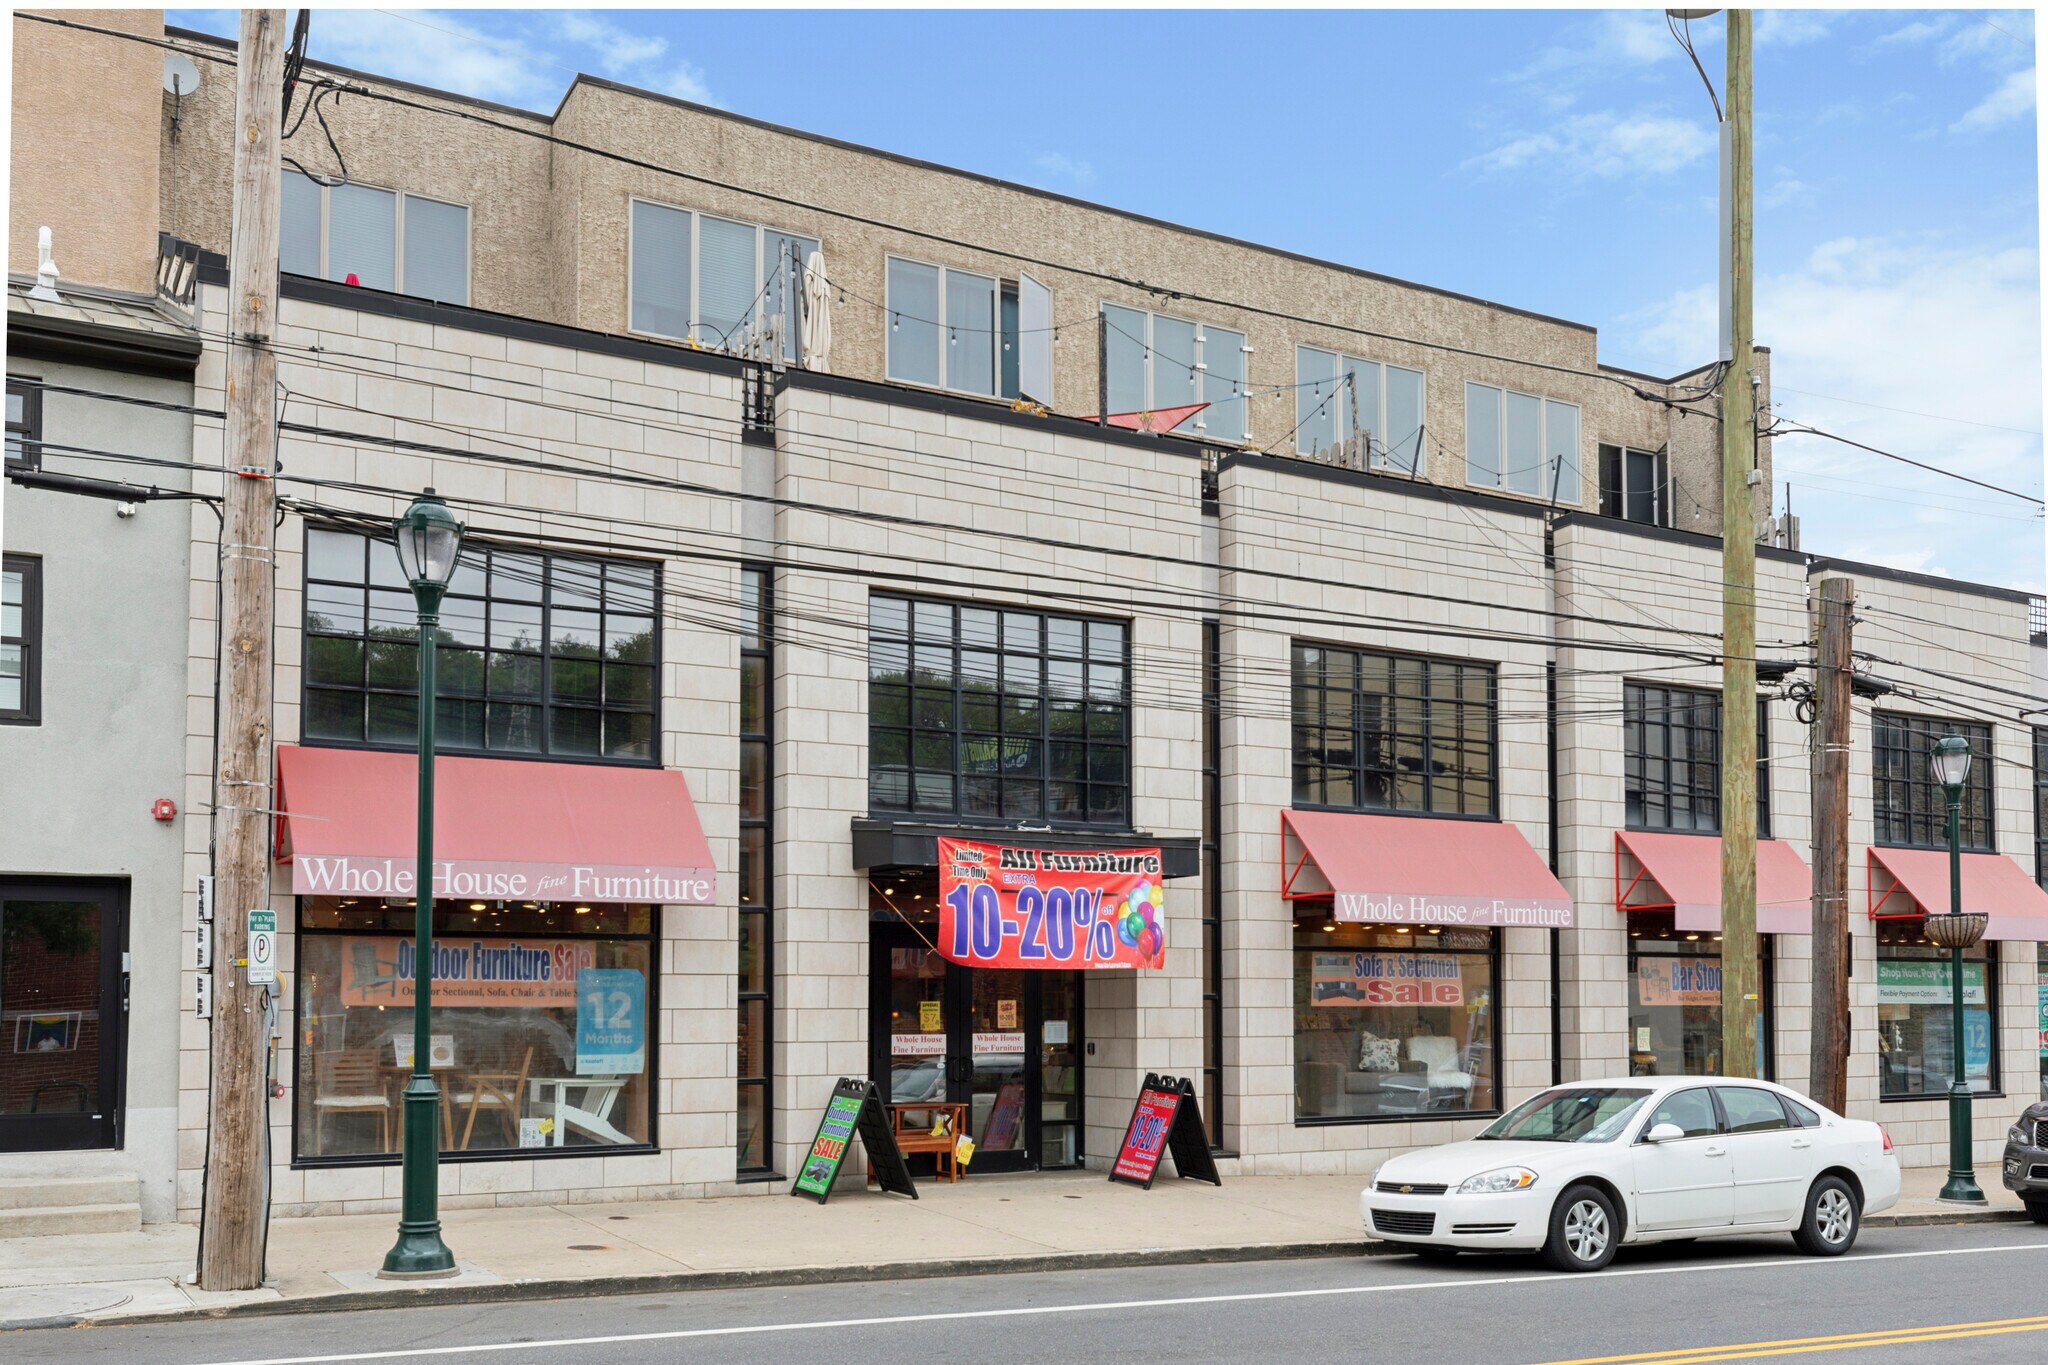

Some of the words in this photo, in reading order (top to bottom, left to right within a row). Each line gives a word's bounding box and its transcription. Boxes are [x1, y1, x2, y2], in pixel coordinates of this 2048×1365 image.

[956, 849, 983, 863] Limited
[1000, 848, 1037, 872] All
[1040, 851, 1160, 875] Furniture
[299, 857, 414, 894] Whole
[432, 862, 527, 897] House
[531, 875, 568, 897] fine
[571, 867, 709, 901] Furniture
[952, 865, 970, 878] Time
[970, 867, 987, 880] Only
[1003, 873, 1037, 884] EXTRA
[1102, 905, 1113, 915] off
[1341, 894, 1404, 921] Whole
[1409, 896, 1467, 923] House
[1469, 905, 1489, 924] fine
[1492, 900, 1571, 926] Furniture
[946, 882, 1115, 961] 10-20%
[258, 938, 265, 957] P
[472, 941, 551, 983] Furniture
[553, 942, 593, 982] Sale
[1354, 953, 1384, 979] Sofa
[1386, 956, 1396, 978] &
[1398, 955, 1459, 979] Sectional
[1671, 960, 1693, 992] Bar
[1880, 967, 1901, 981] Shop
[1902, 968, 1920, 978] Now.
[1920, 968, 1937, 981] Pay
[442, 987, 485, 998] Sectional,
[510, 987, 536, 998] Chair
[550, 988, 573, 998] Table
[1366, 980, 1461, 1004] Sale
[1898, 990, 1919, 999] Payment
[1920, 990, 1938, 999] Options
[587, 991, 633, 1029] 12
[585, 1033, 633, 1044] Months
[896, 1034, 919, 1043] Whole
[920, 1034, 943, 1043] House
[976, 1034, 998, 1043] Whole
[1000, 1033, 1022, 1042] House
[1967, 1024, 1986, 1048] 12
[893, 1045, 910, 1054] Fine
[911, 1045, 945, 1054] Furniture
[974, 1045, 990, 1053] Fine
[991, 1044, 1024, 1053] Furniture
[1152, 1093, 1177, 1109] Furniture
[827, 1106, 857, 1123] Outdoor
[821, 1121, 851, 1138] Furniture
[1127, 1114, 1165, 1152] 10-20%
[813, 1137, 844, 1161] SALE
